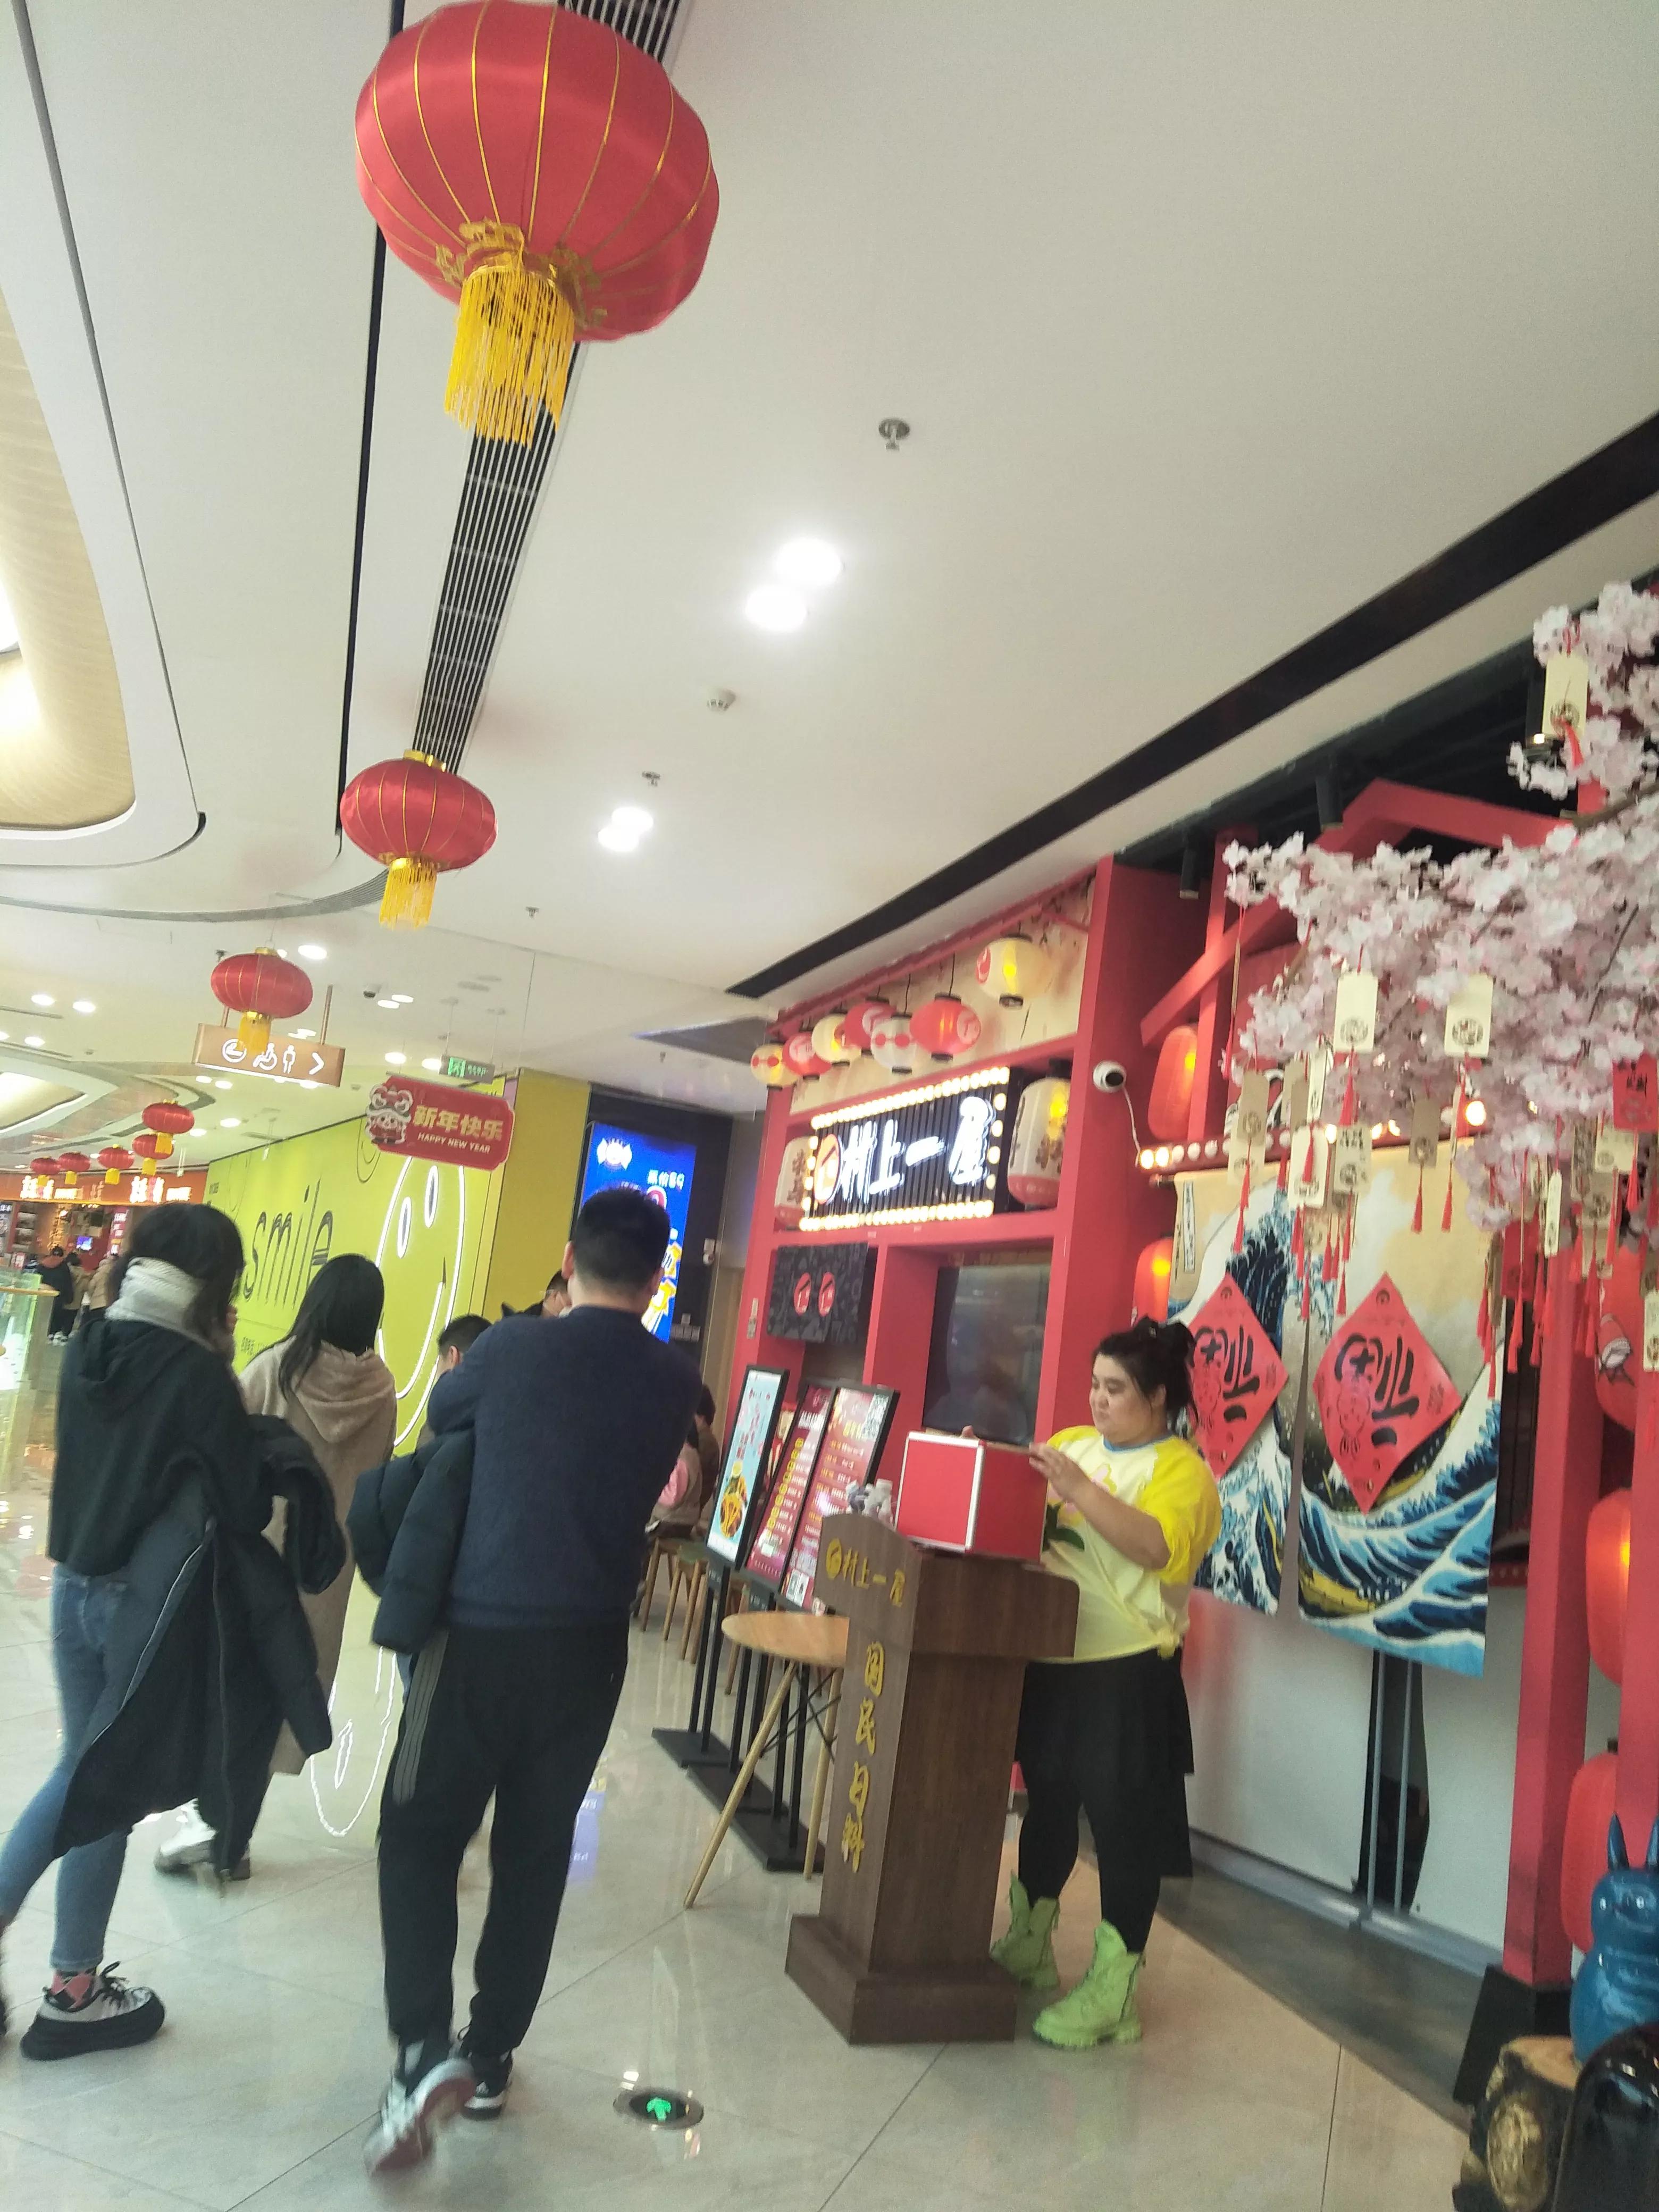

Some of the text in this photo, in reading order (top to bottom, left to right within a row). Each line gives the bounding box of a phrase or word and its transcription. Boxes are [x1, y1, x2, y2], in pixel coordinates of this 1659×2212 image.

[413, 1105, 504, 1141] 新年快乐
[417, 1132, 491, 1154] HAPPY NEW YEAR
[243, 1178, 333, 1310] smile
